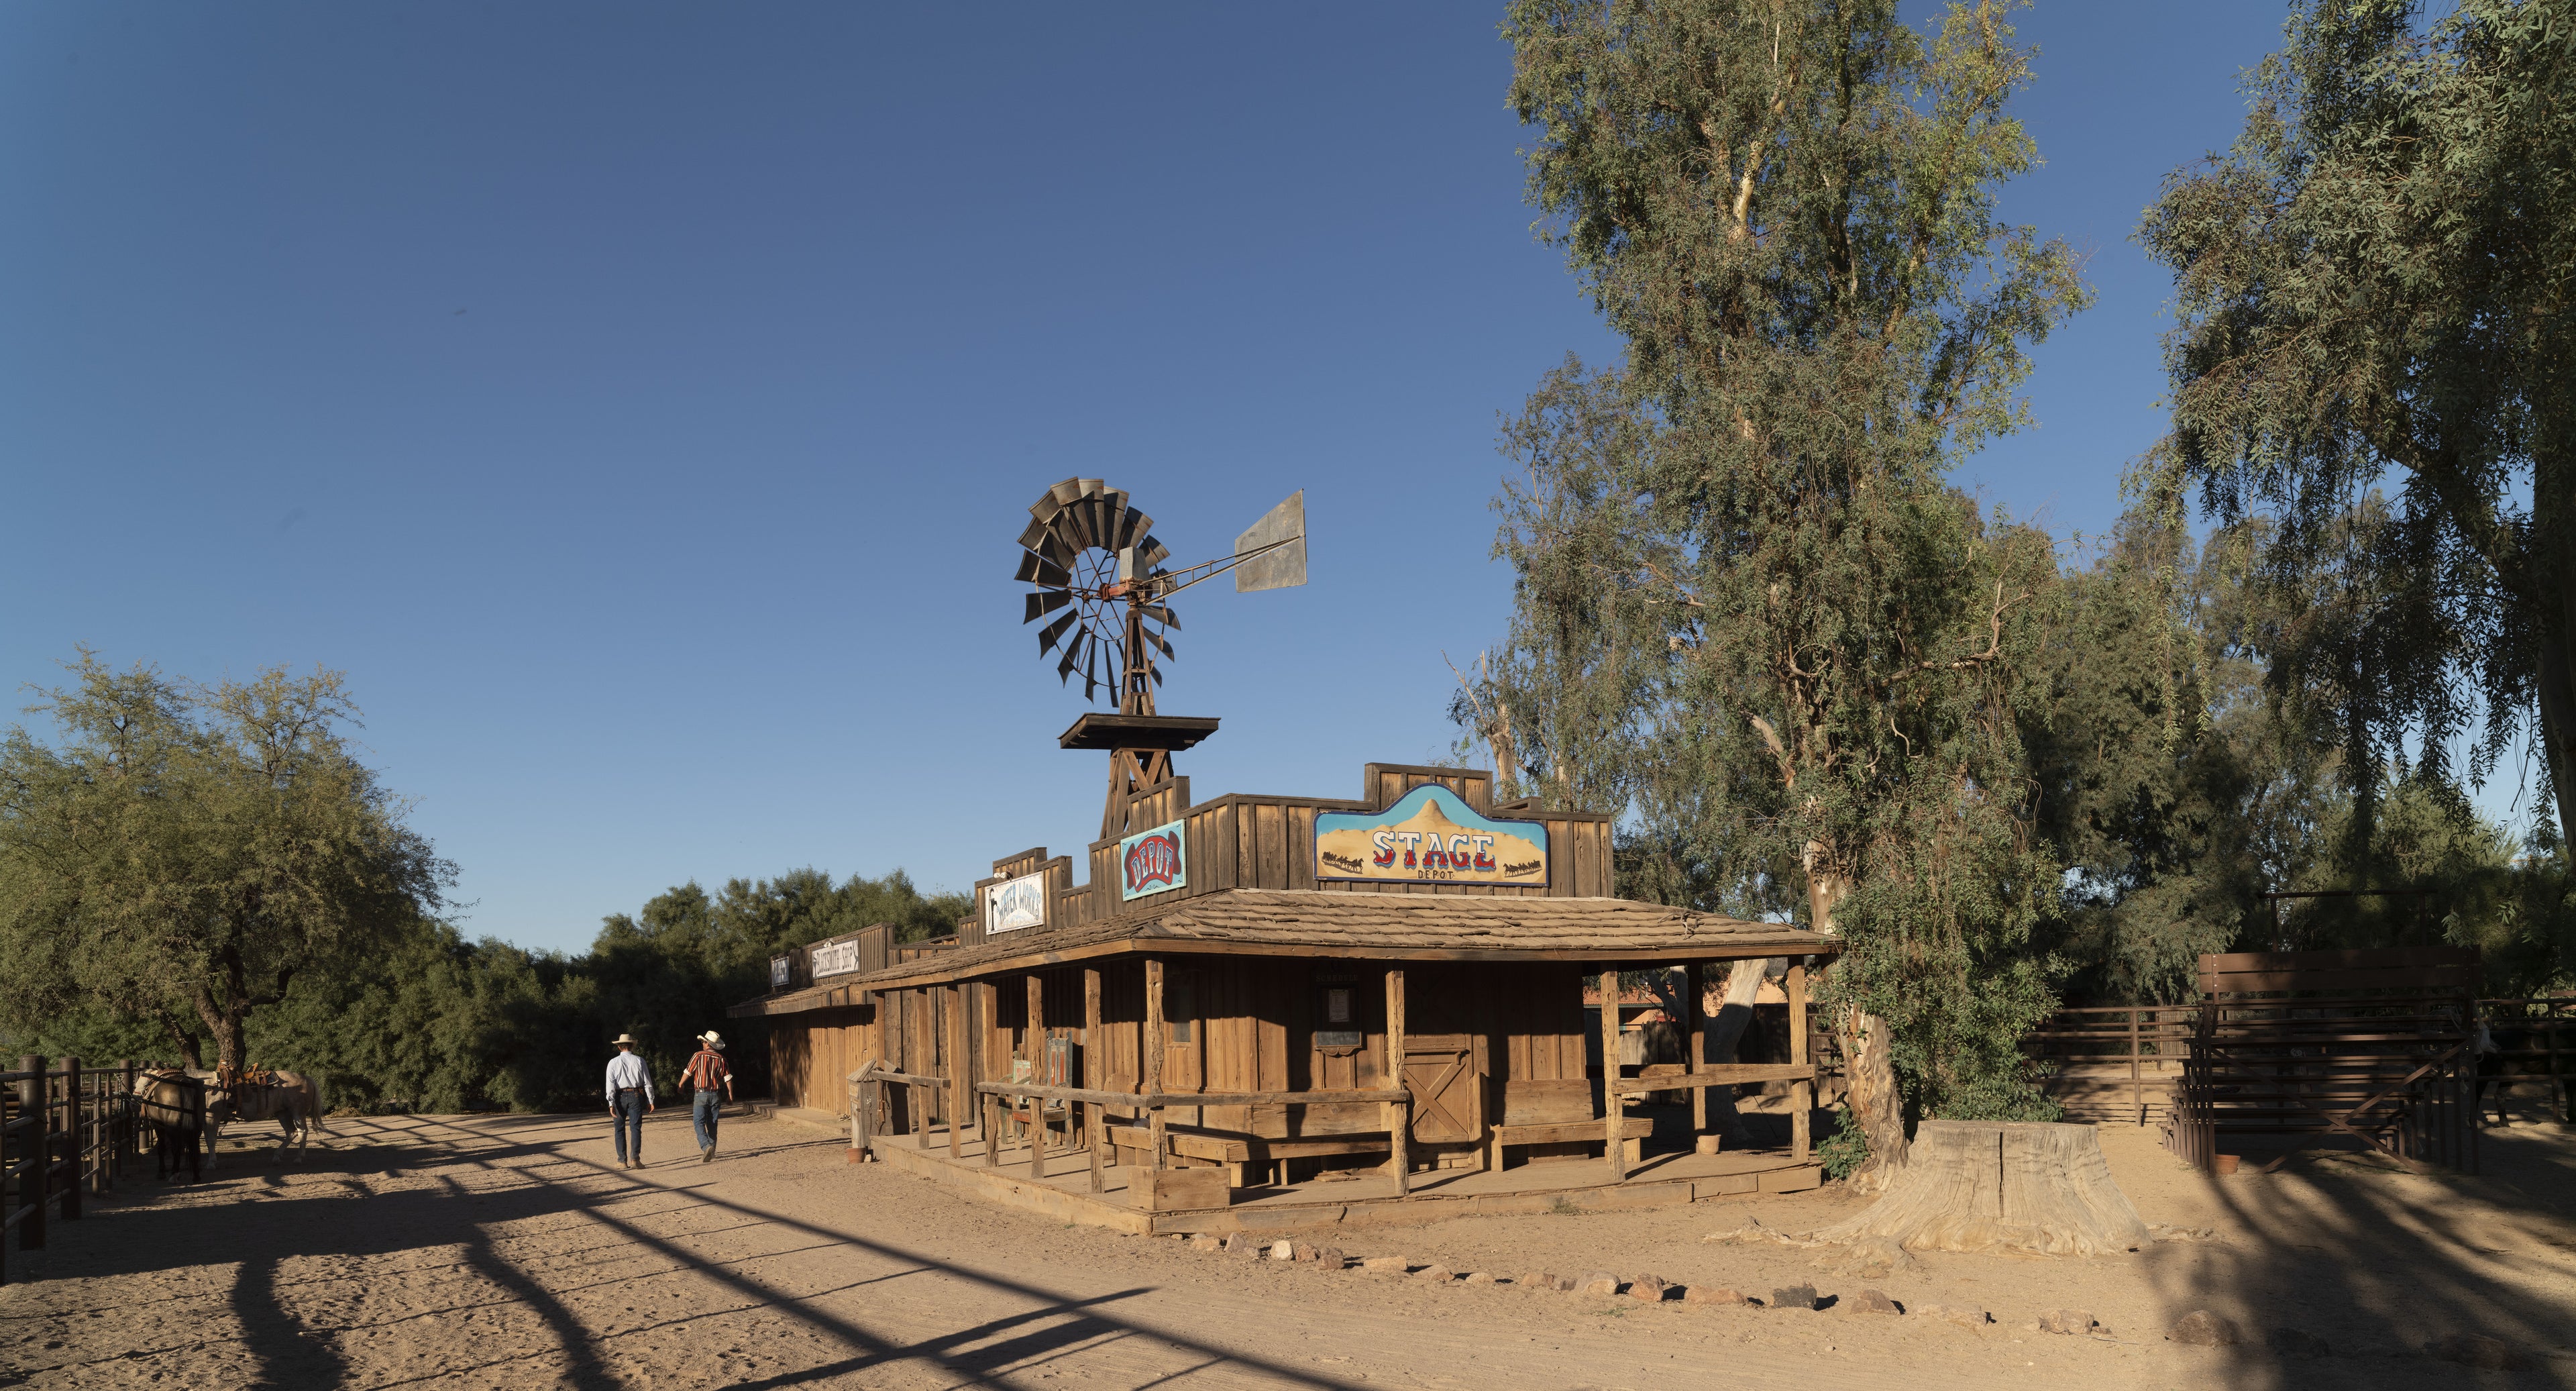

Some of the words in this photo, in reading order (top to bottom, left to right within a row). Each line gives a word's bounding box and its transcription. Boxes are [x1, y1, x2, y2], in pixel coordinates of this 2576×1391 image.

[1131, 841, 1173, 887] DEPOT
[1373, 831, 1497, 870] STAGE
[1417, 870, 1454, 880] DEPOT
[997, 884, 1018, 925] WATER
[1019, 881, 1041, 921] WORKS
[842, 945, 853, 970] SHOP
